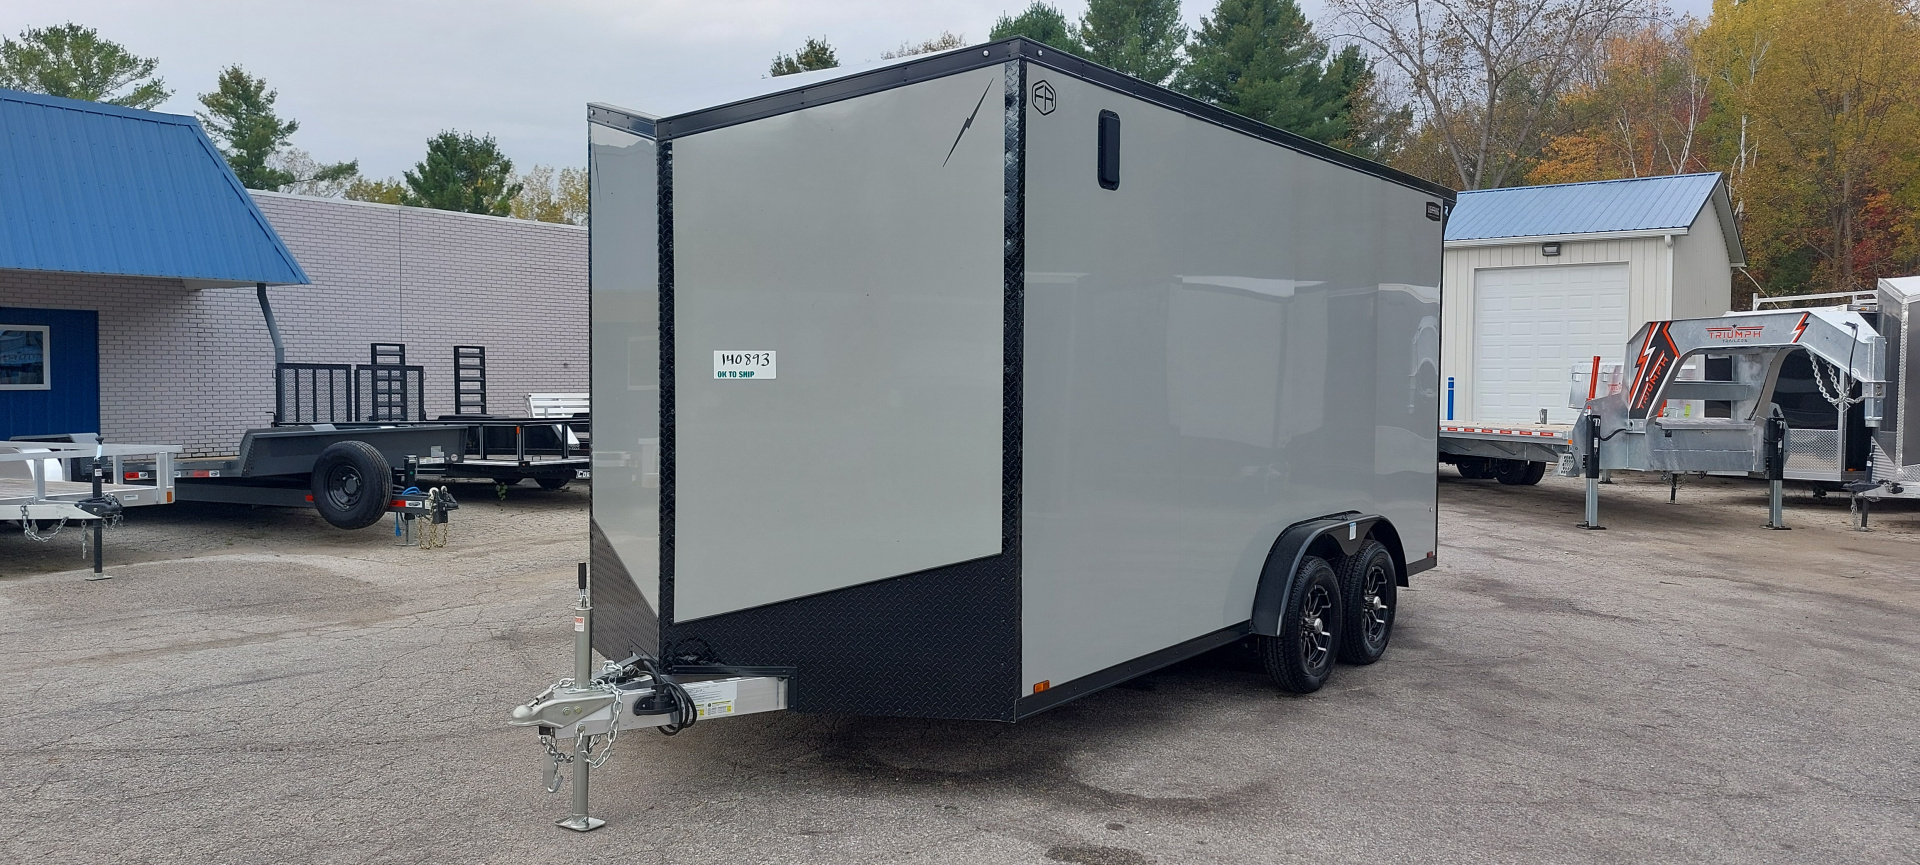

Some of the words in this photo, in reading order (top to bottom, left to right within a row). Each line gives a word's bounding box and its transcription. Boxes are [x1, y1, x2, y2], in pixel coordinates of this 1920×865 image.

[1709, 329, 1761, 339] TRIUMPH
[721, 352, 770, 367] 140893
[717, 370, 727, 378] OK
[728, 370, 737, 378] TO
[738, 370, 755, 378] SHIP
[1639, 356, 1669, 409] TRIUMPH
